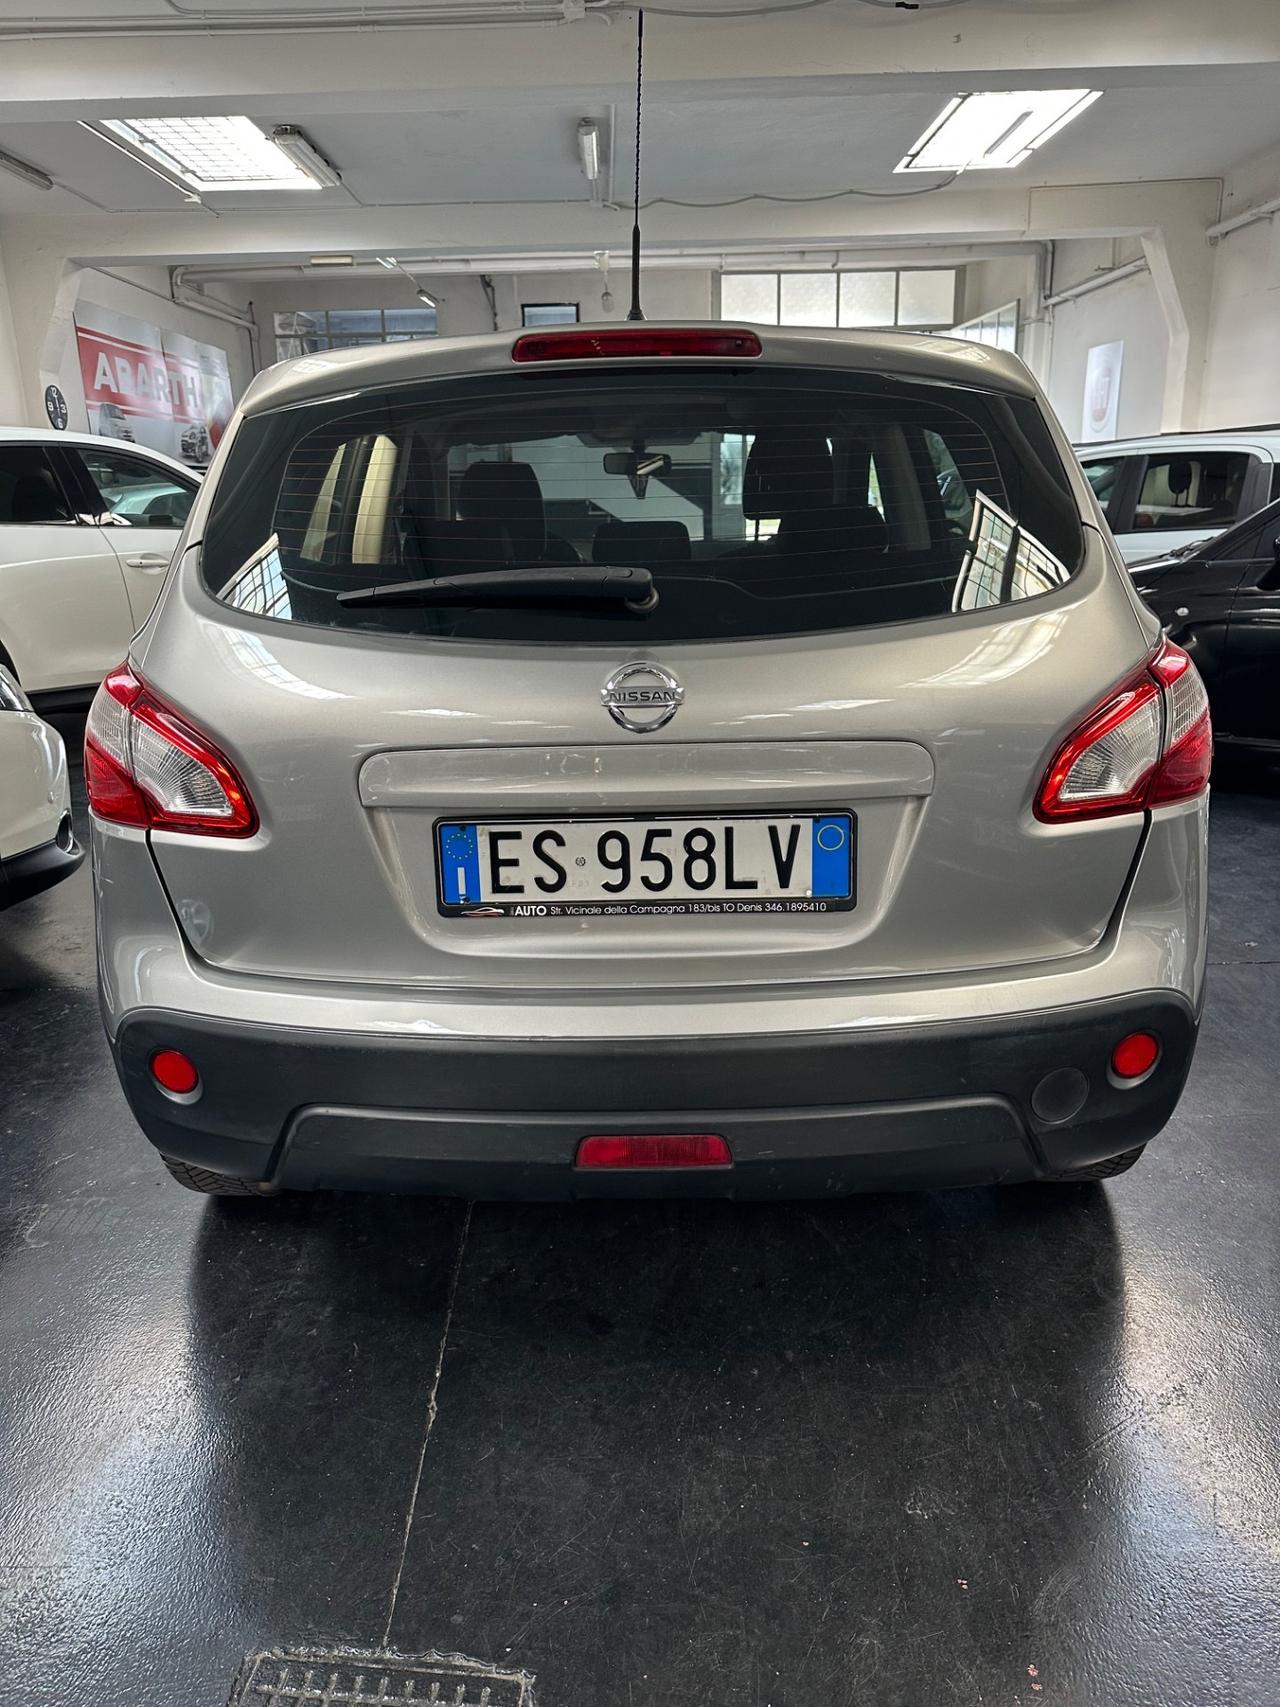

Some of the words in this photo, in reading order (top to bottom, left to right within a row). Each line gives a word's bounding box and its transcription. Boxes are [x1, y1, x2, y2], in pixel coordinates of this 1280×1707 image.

[94, 352, 200, 408] ABARTH
[47, 401, 54, 411] 9
[60, 403, 67, 414] 3
[609, 691, 676, 702] NISSAN
[488, 830, 568, 894] ES
[597, 823, 801, 893] 958LV
[514, 905, 547, 916] AUTO
[550, 905, 563, 915] Str.
[565, 905, 602, 915] Vicinale
[603, 906, 628, 915] della
[629, 904, 686, 915] Campagna
[688, 903, 721, 913] 183/bis
[722, 903, 735, 912] TO
[736, 903, 763, 912] Denis
[764, 902, 827, 912] 346.1895410
